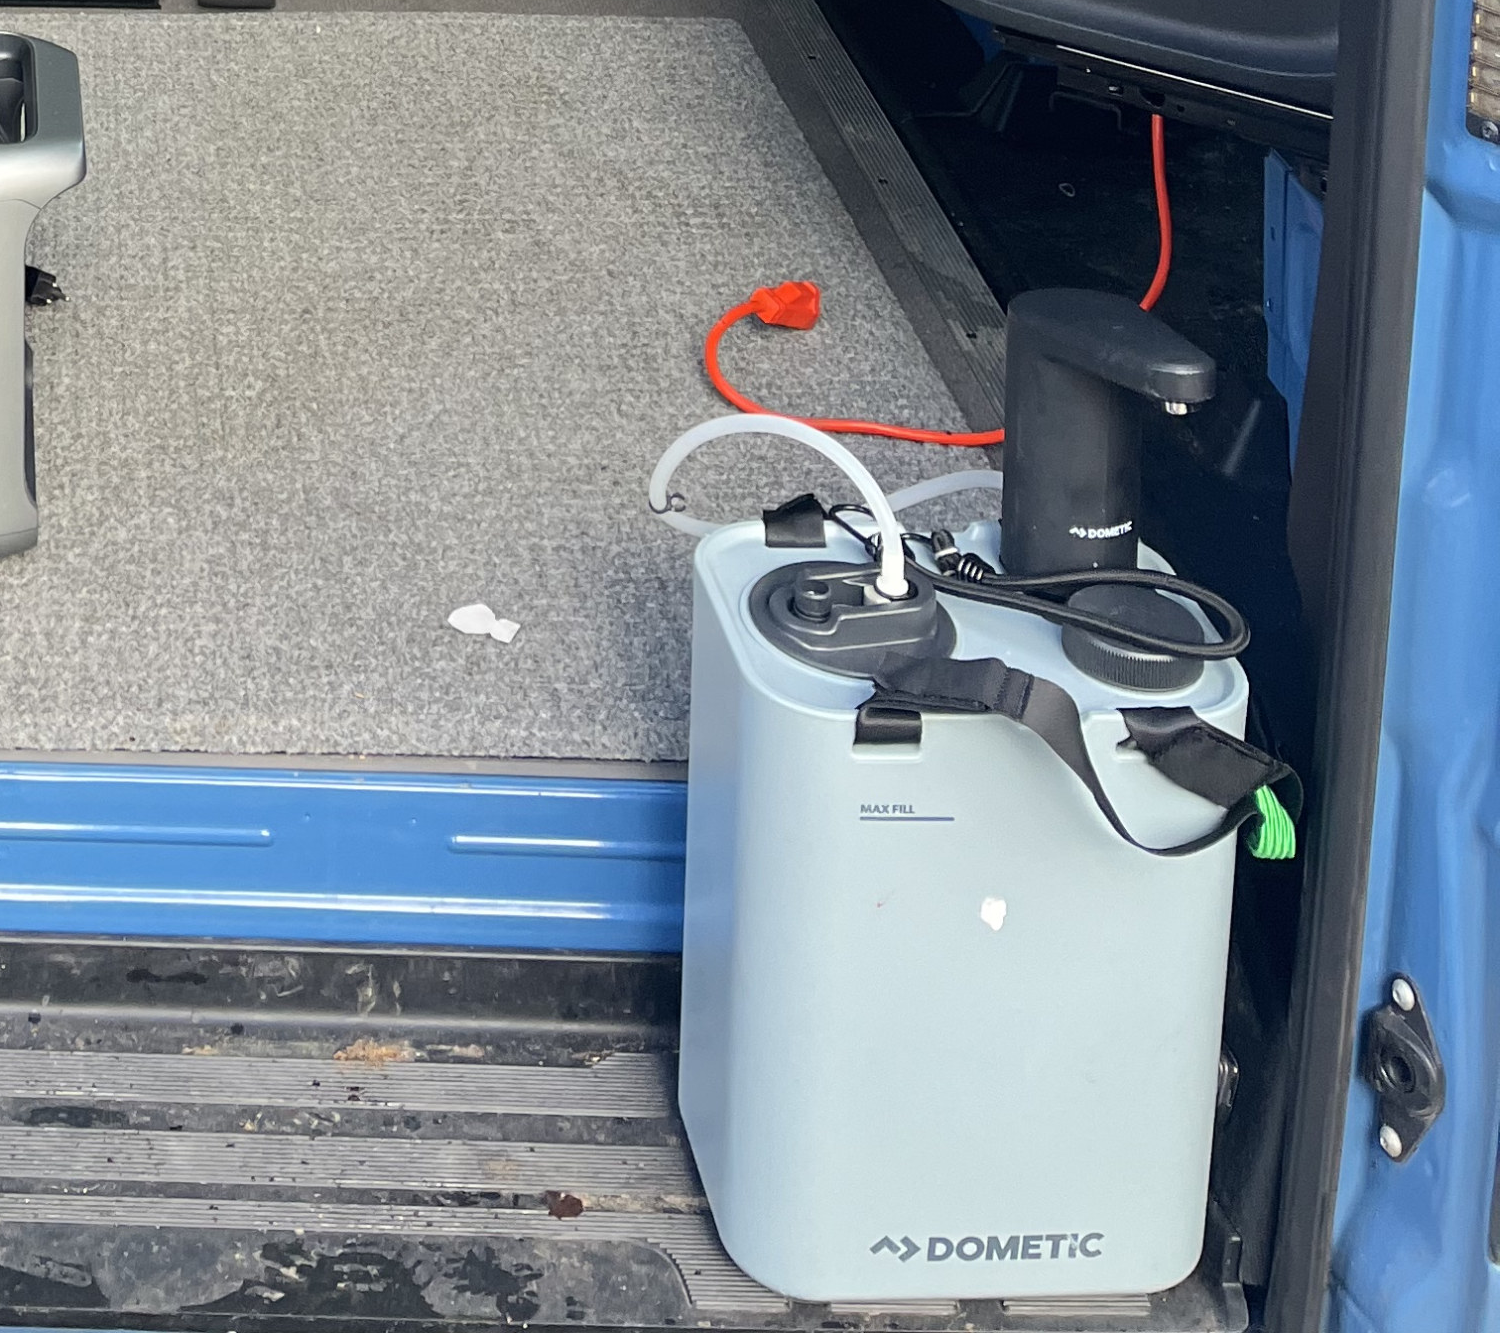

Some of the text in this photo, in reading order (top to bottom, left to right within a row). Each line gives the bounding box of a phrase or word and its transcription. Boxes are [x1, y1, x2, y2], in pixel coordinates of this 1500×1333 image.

[860, 804, 916, 814] MAX FILL
[926, 1232, 1105, 1262] DOMETIC
